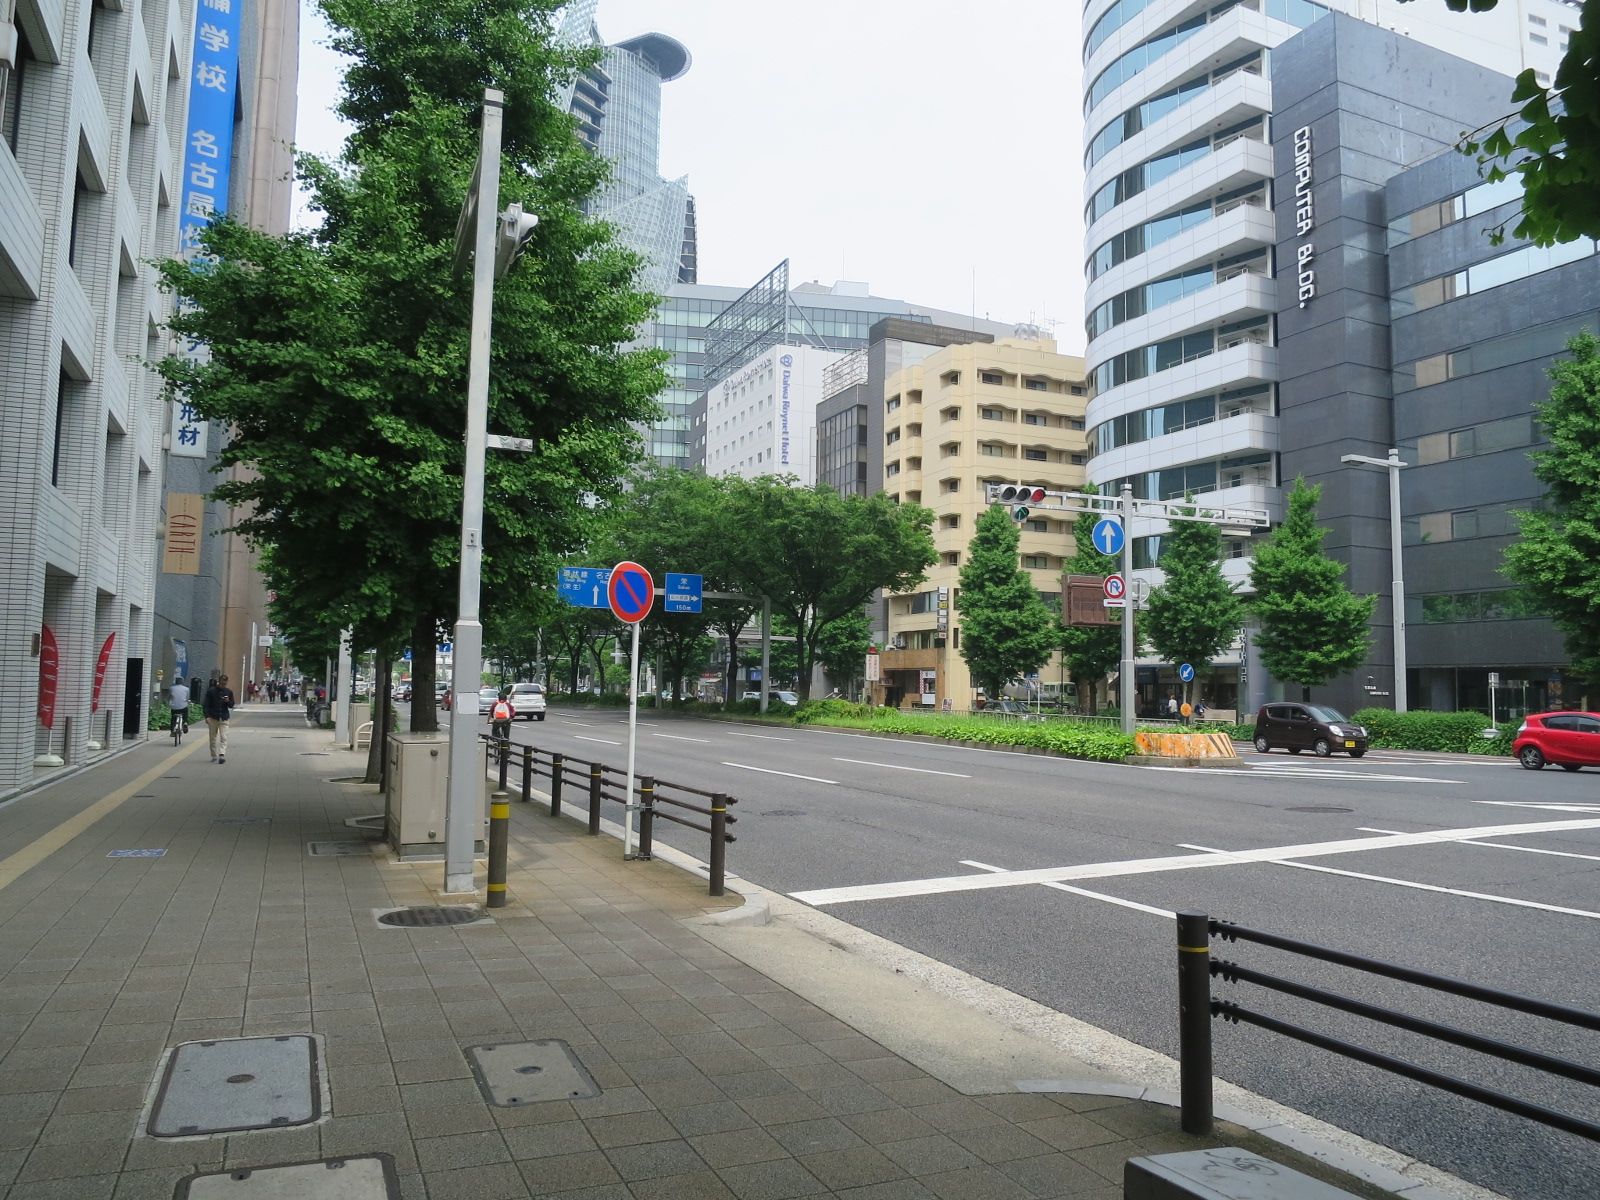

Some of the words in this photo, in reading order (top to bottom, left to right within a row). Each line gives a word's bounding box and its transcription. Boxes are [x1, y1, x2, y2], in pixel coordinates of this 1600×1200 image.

[1293, 125, 1313, 237] COMPUTER
[1297, 243, 1315, 309] BLDG.
[781, 370, 792, 399] Daiwa
[780, 401, 791, 434] Roynet
[781, 437, 790, 465] Hotel
[168, 515, 197, 554] EARTH
